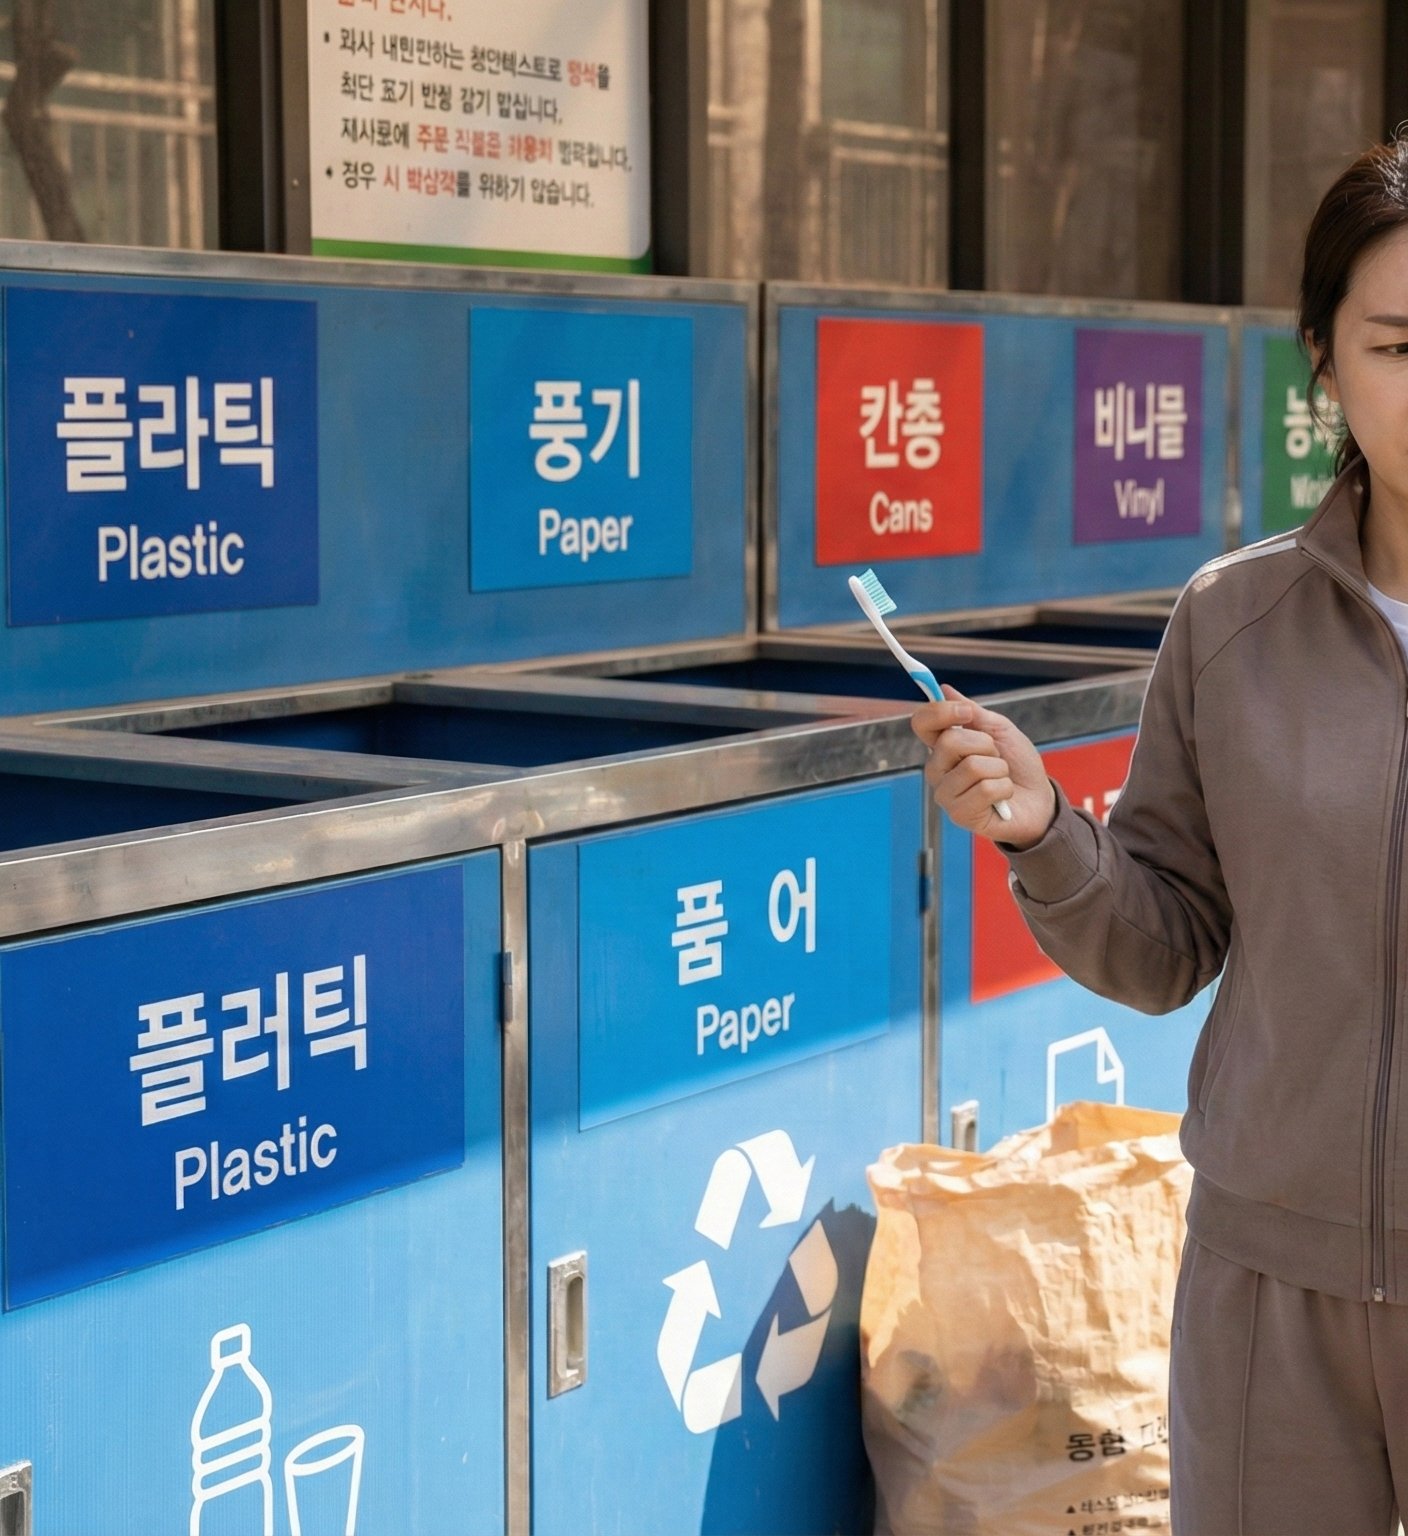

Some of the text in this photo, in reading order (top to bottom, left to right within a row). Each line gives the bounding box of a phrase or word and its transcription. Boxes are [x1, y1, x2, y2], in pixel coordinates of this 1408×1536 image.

[417, 124, 449, 153] 주문
[383, 165, 400, 192] 시
[56, 376, 274, 492] 플라틱
[529, 379, 640, 482] 풍기
[859, 378, 944, 470] 칸총
[869, 490, 934, 536] Cans
[1114, 477, 1165, 525] Vinyl
[98, 520, 245, 582] Plastic
[539, 508, 633, 562] Paper
[130, 954, 368, 1127] 플러틱
[697, 992, 796, 1056] Paper
[174, 1115, 338, 1210] Plastic
